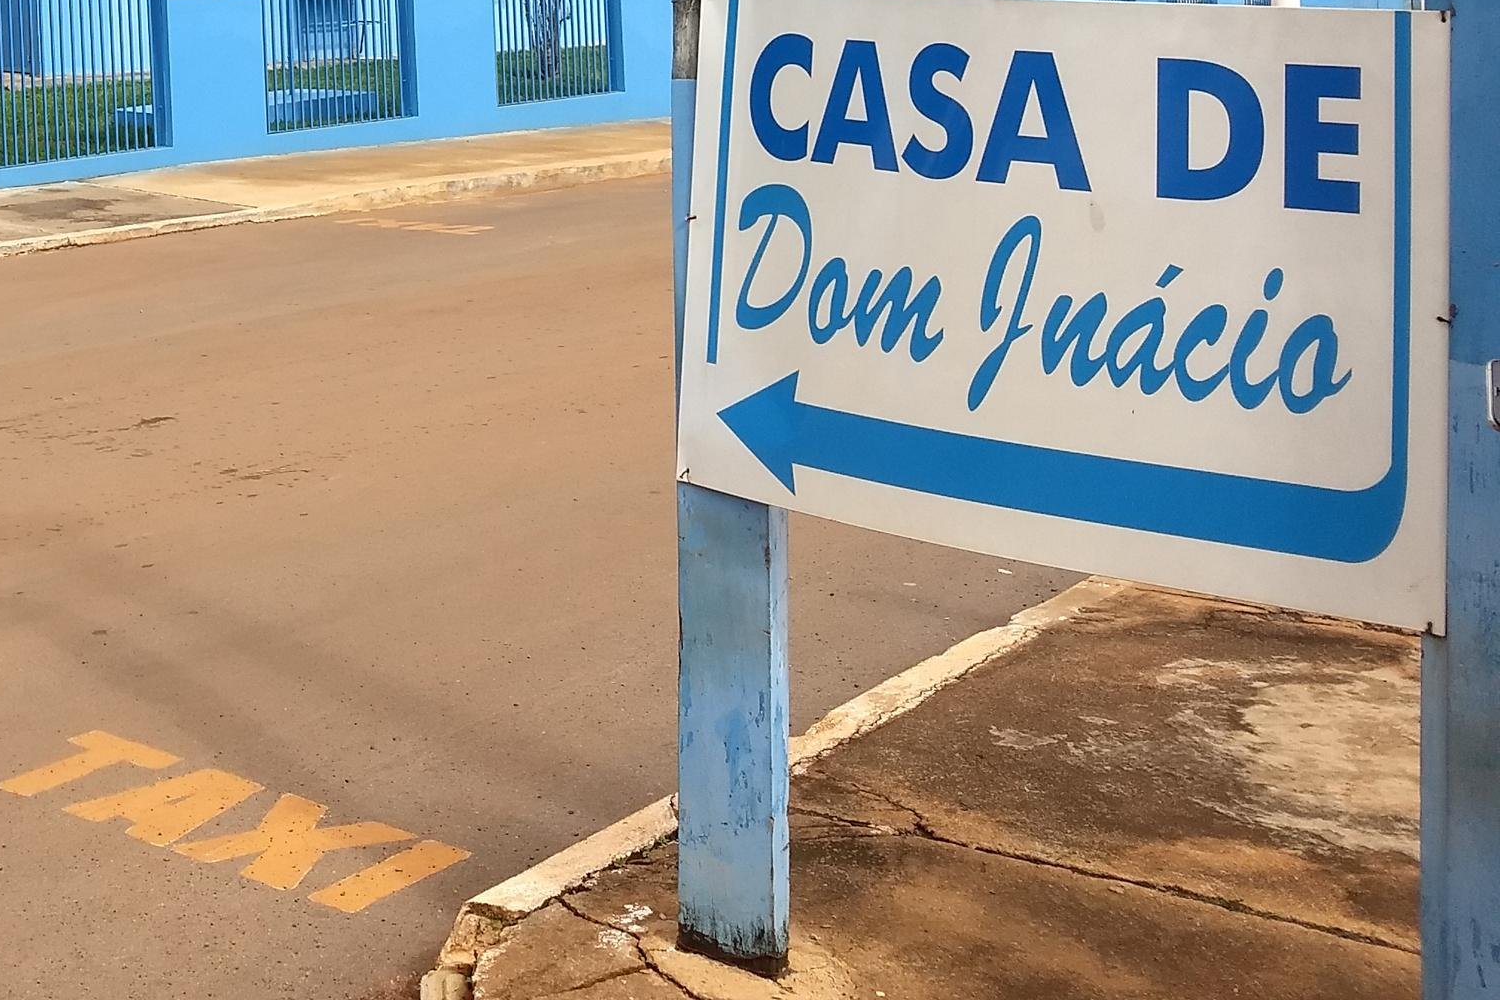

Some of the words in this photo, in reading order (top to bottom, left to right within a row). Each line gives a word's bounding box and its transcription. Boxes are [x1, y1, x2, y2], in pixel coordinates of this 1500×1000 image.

[749, 33, 1092, 191] CASA
[1156, 57, 1361, 214] DE
[736, 182, 944, 362] Dom
[967, 215, 1352, 414] Inácio
